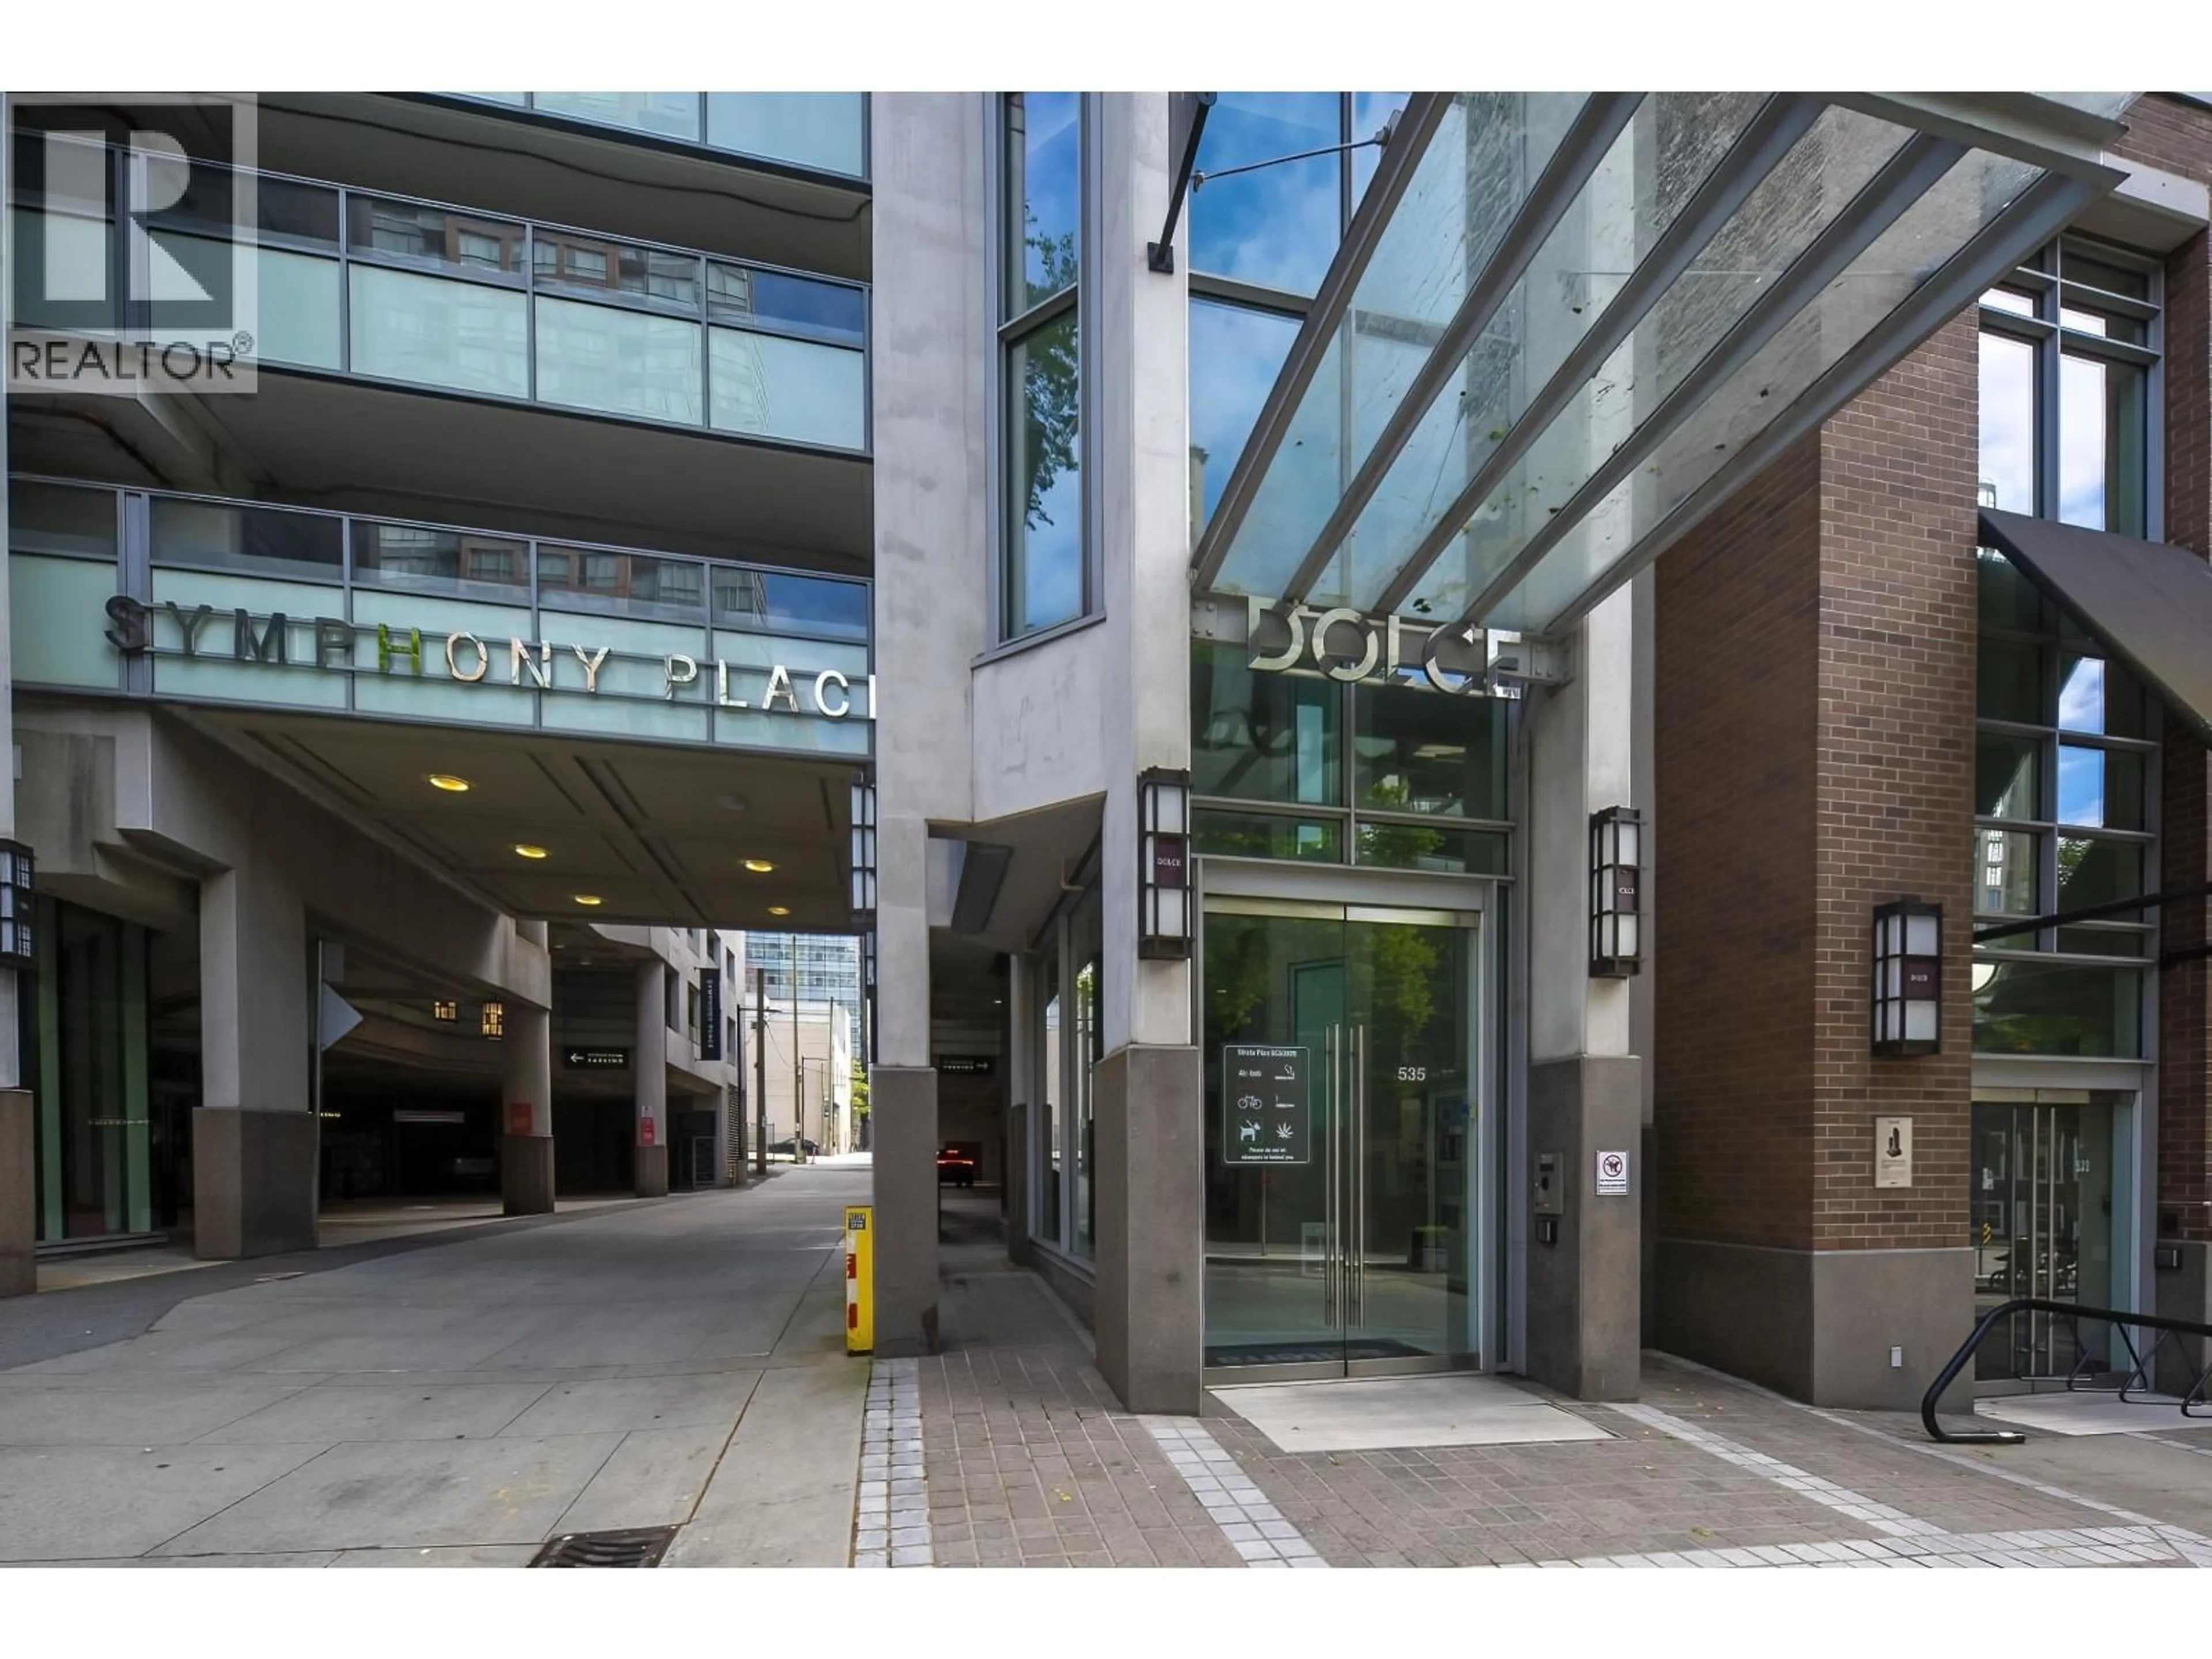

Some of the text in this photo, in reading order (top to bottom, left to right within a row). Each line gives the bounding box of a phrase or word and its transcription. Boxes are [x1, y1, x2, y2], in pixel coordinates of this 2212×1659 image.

[104, 595, 876, 719] SYMPHONY PLAC
[1248, 596, 1521, 699] DOLCE
[1398, 1067, 1426, 1081] 535
